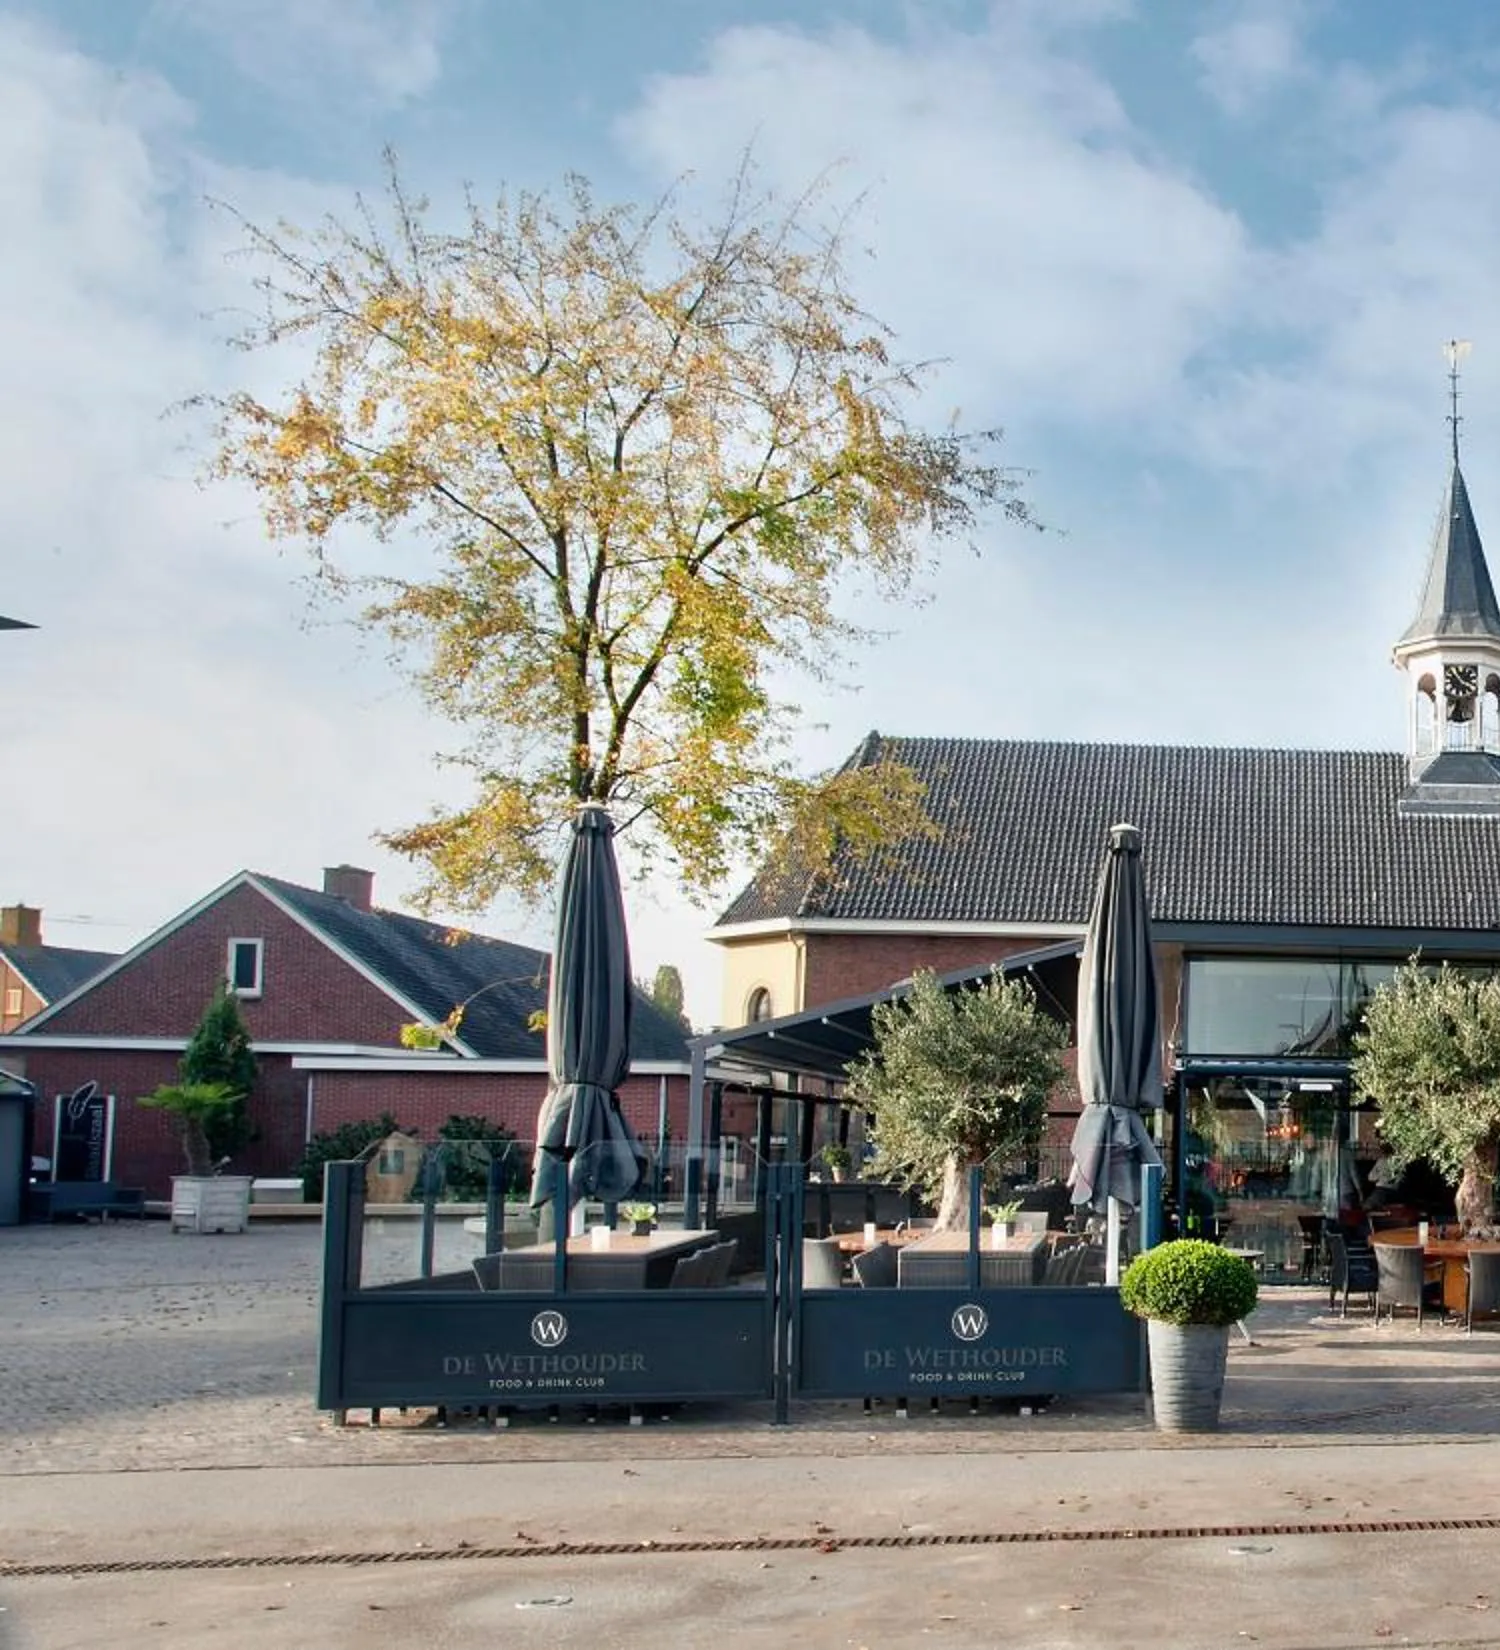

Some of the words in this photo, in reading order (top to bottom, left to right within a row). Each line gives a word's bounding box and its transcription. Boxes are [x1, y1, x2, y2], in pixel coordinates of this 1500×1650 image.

[537, 1311, 564, 1340] W
[957, 1305, 984, 1335] W
[443, 1355, 476, 1375] DE
[483, 1352, 647, 1375] WETHOUDER
[863, 1349, 896, 1369] DE
[905, 1346, 1068, 1368] WETHOUDER
[489, 1379, 523, 1389] FOOD
[526, 1379, 533, 1388] &
[537, 1378, 572, 1388] DRINK
[575, 1377, 605, 1387] CLUB
[909, 1372, 943, 1383] FOOD
[946, 1373, 953, 1381] &
[957, 1371, 993, 1382] DRINK
[996, 1371, 1025, 1381] CLUB
